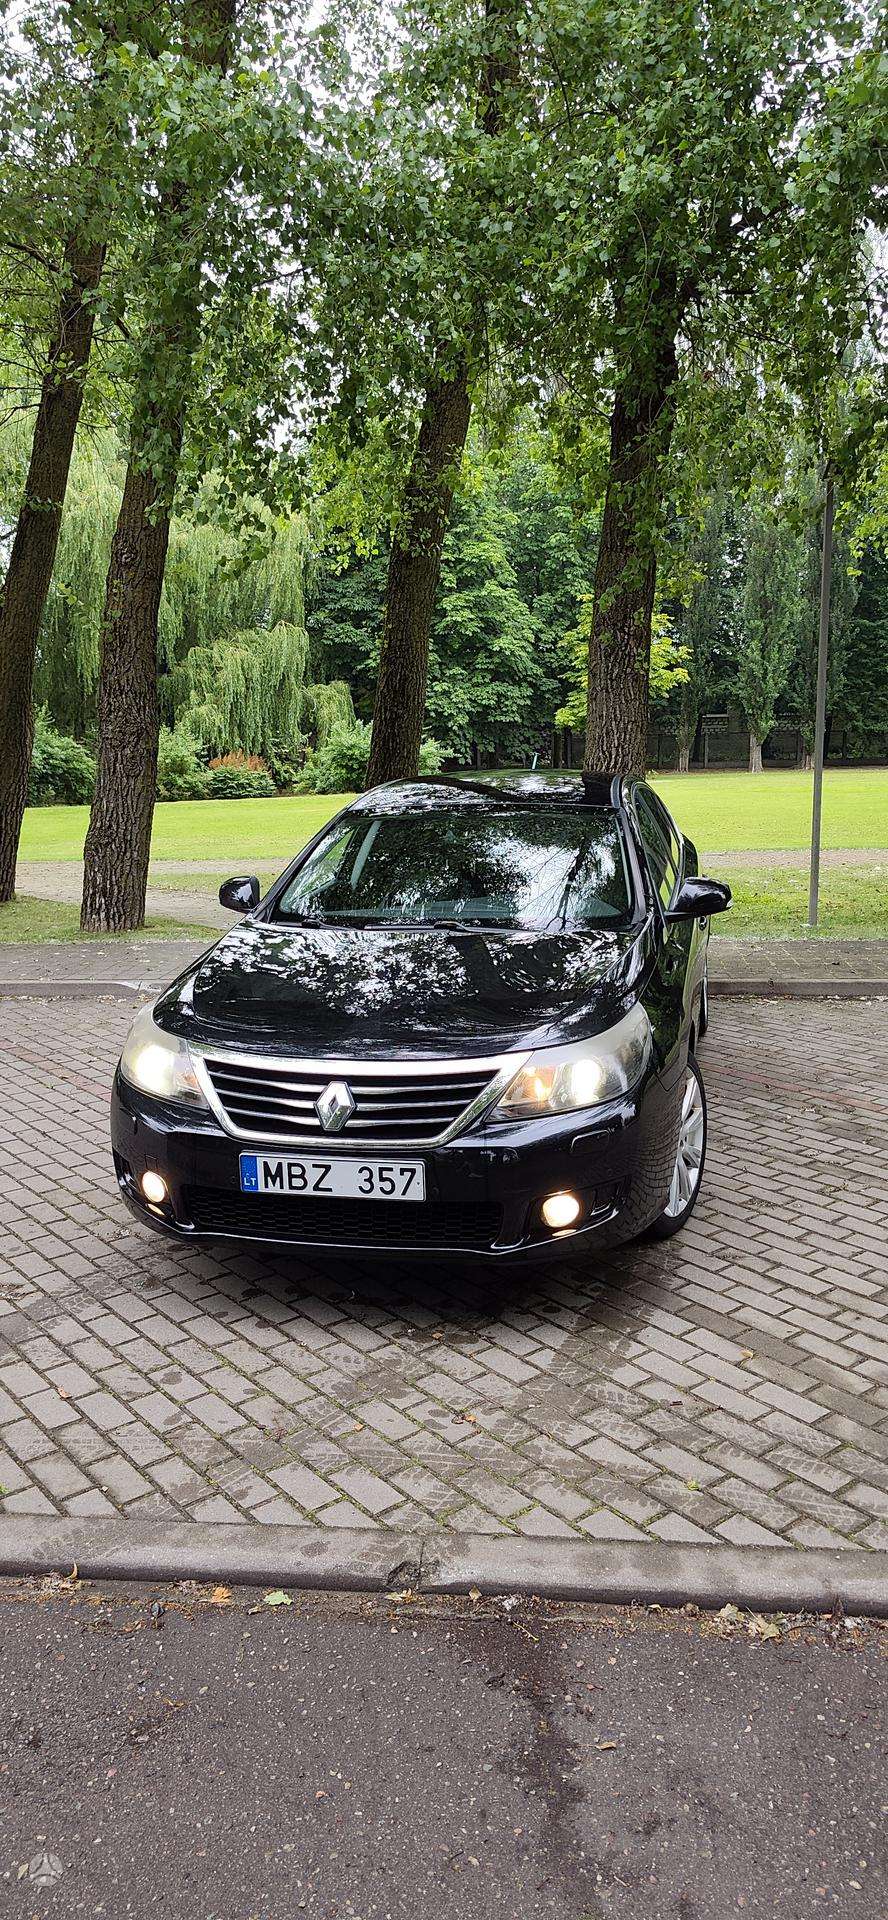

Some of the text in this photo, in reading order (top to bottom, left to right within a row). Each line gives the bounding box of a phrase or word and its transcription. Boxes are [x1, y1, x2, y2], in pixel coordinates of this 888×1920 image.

[243, 1176, 257, 1187] LT
[262, 1161, 416, 1196] MBZ 357
